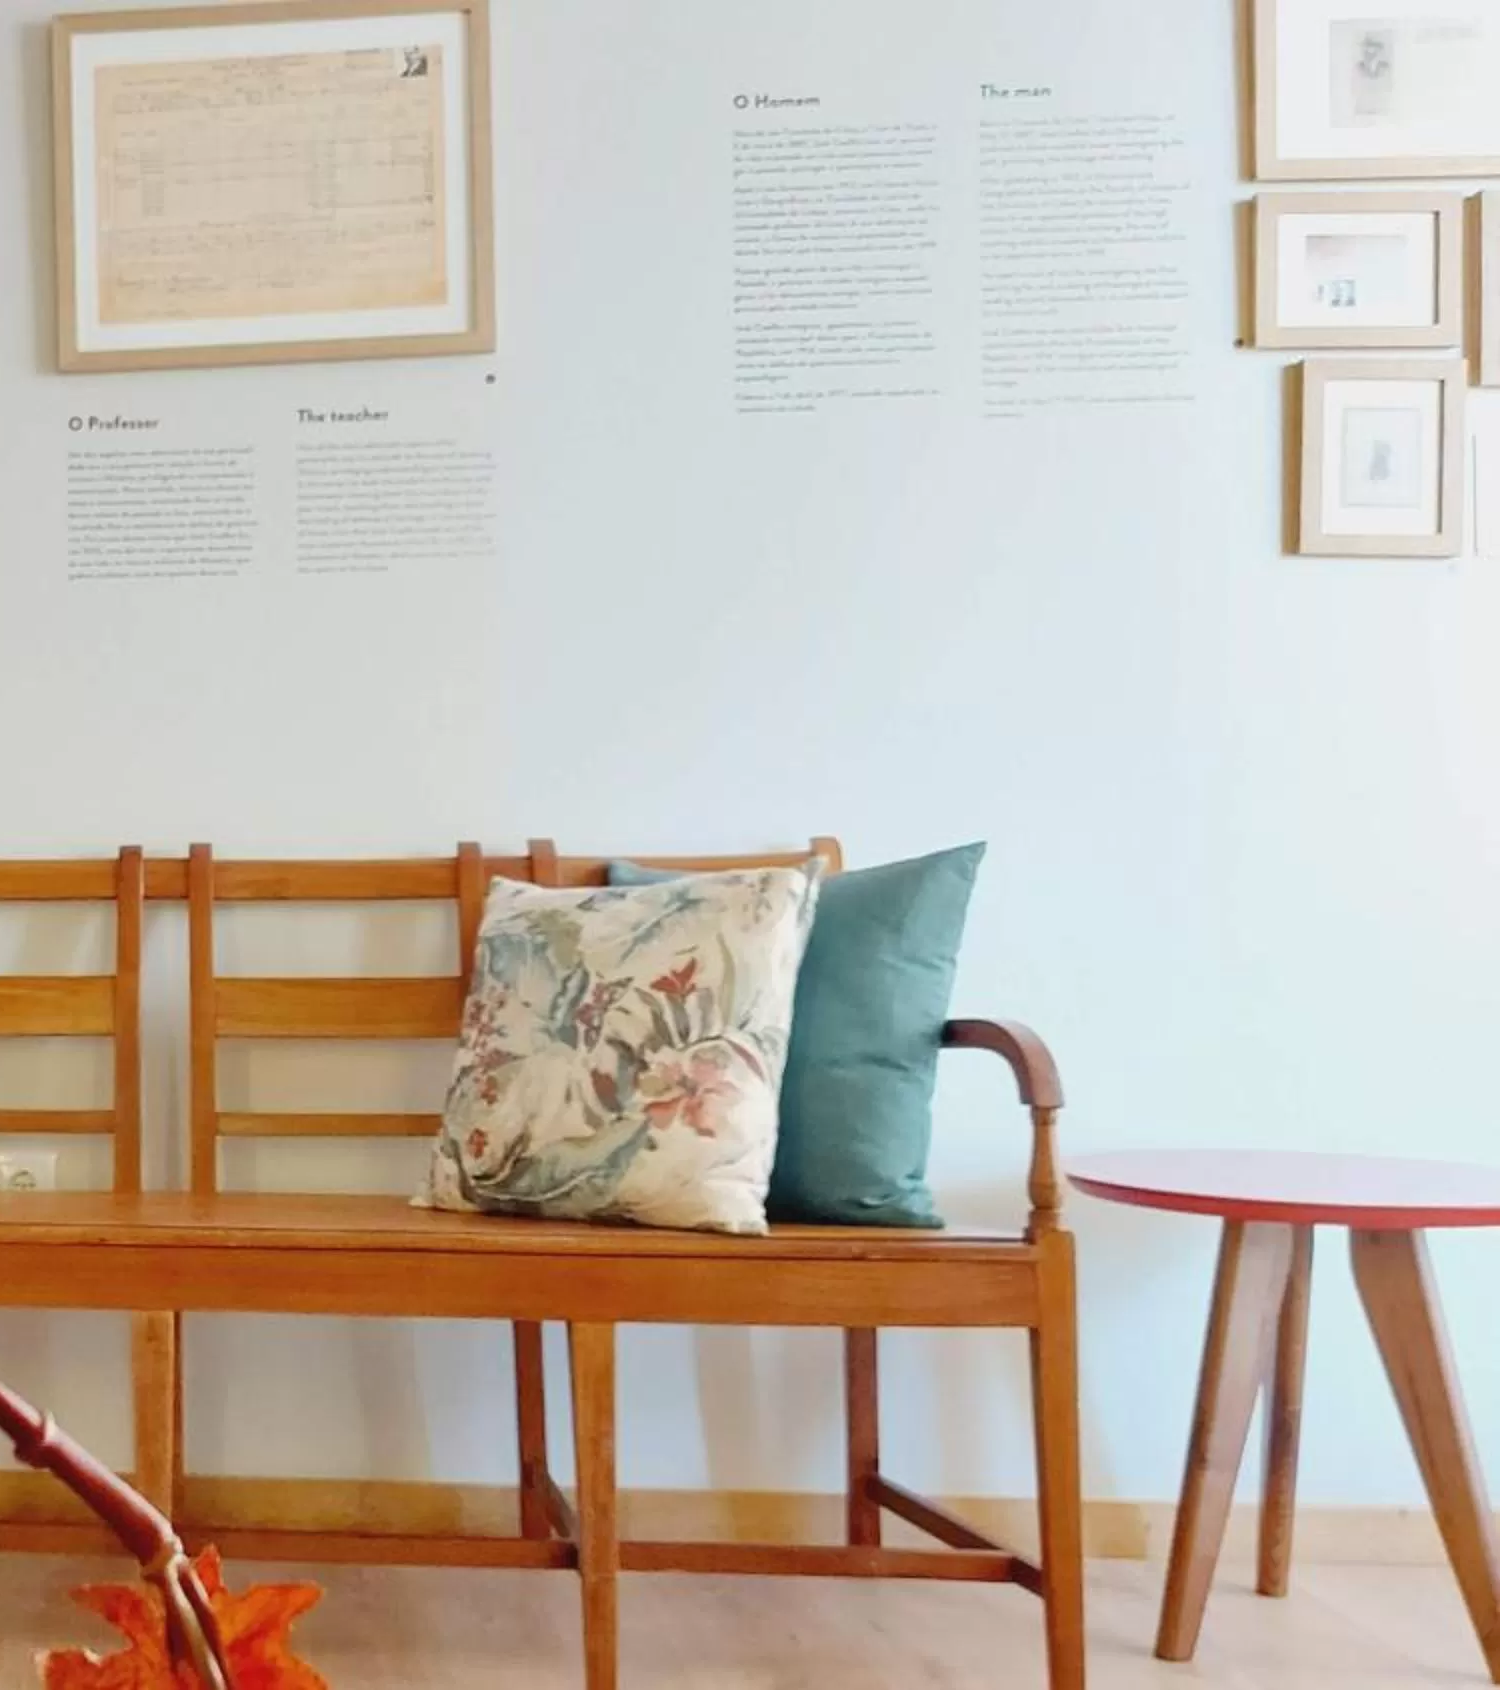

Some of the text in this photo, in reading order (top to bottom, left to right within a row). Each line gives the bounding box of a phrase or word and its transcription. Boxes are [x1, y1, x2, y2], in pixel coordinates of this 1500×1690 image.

[980, 83, 1052, 99] The man
[734, 93, 820, 109] O Homem
[297, 404, 388, 423] The teacher
[68, 414, 159, 431] O Professor
